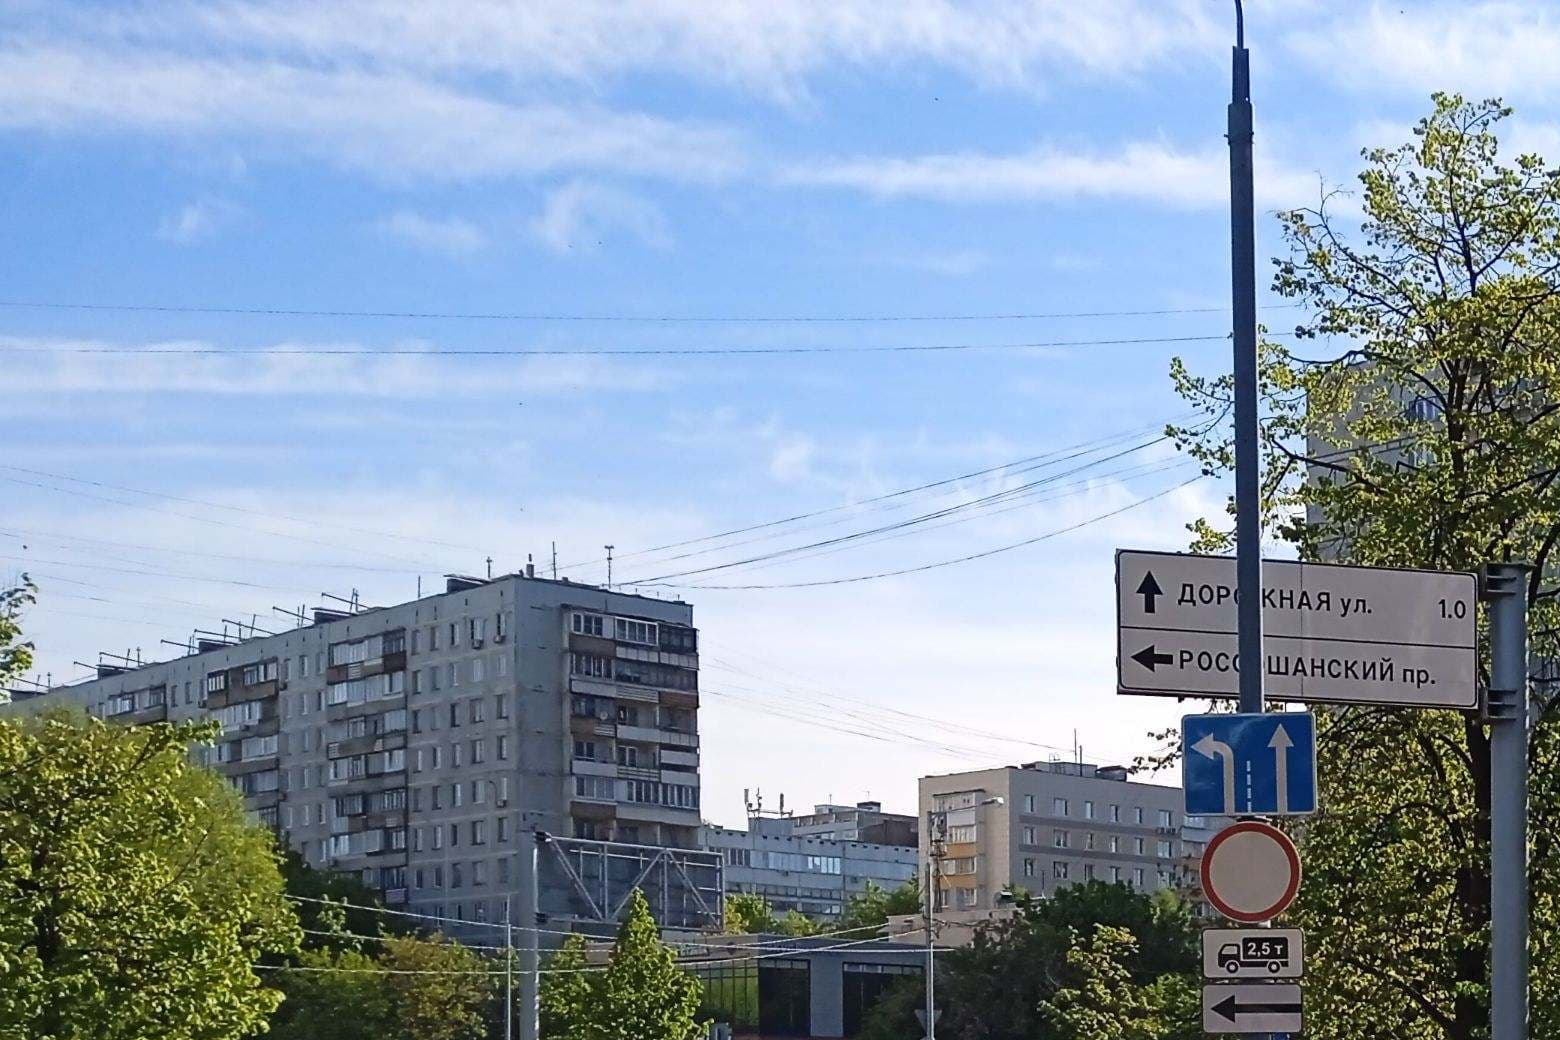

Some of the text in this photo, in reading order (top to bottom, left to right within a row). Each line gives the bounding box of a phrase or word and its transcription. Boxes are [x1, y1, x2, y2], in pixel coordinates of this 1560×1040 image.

[1340, 598, 1373, 618] ул.
[1438, 599, 1467, 619] 1.0
[1179, 650, 1436, 688] РОССШАНСКИЙ пр.
[1247, 942, 1271, 958] 2,5
